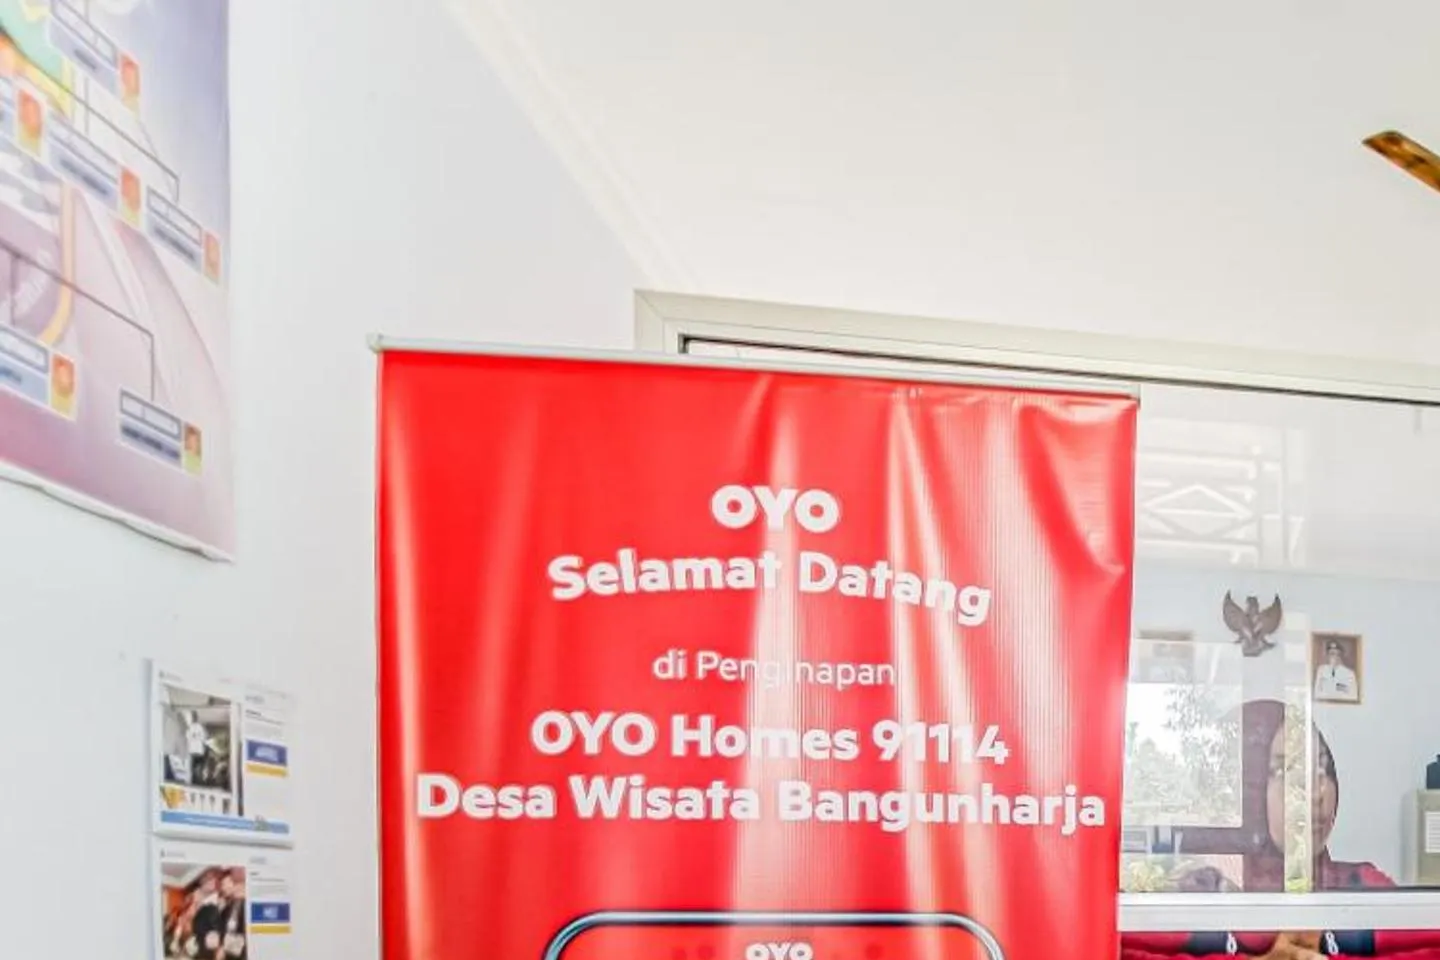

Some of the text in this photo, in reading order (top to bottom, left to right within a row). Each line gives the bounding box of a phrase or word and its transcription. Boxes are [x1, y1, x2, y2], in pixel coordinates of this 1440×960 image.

[711, 484, 840, 533] OYO
[548, 547, 992, 627] Selamat Datang
[653, 649, 687, 680] di
[530, 711, 1010, 766] OYO Homes 91114
[415, 773, 1106, 835] Desa Wisata Bangunharja
